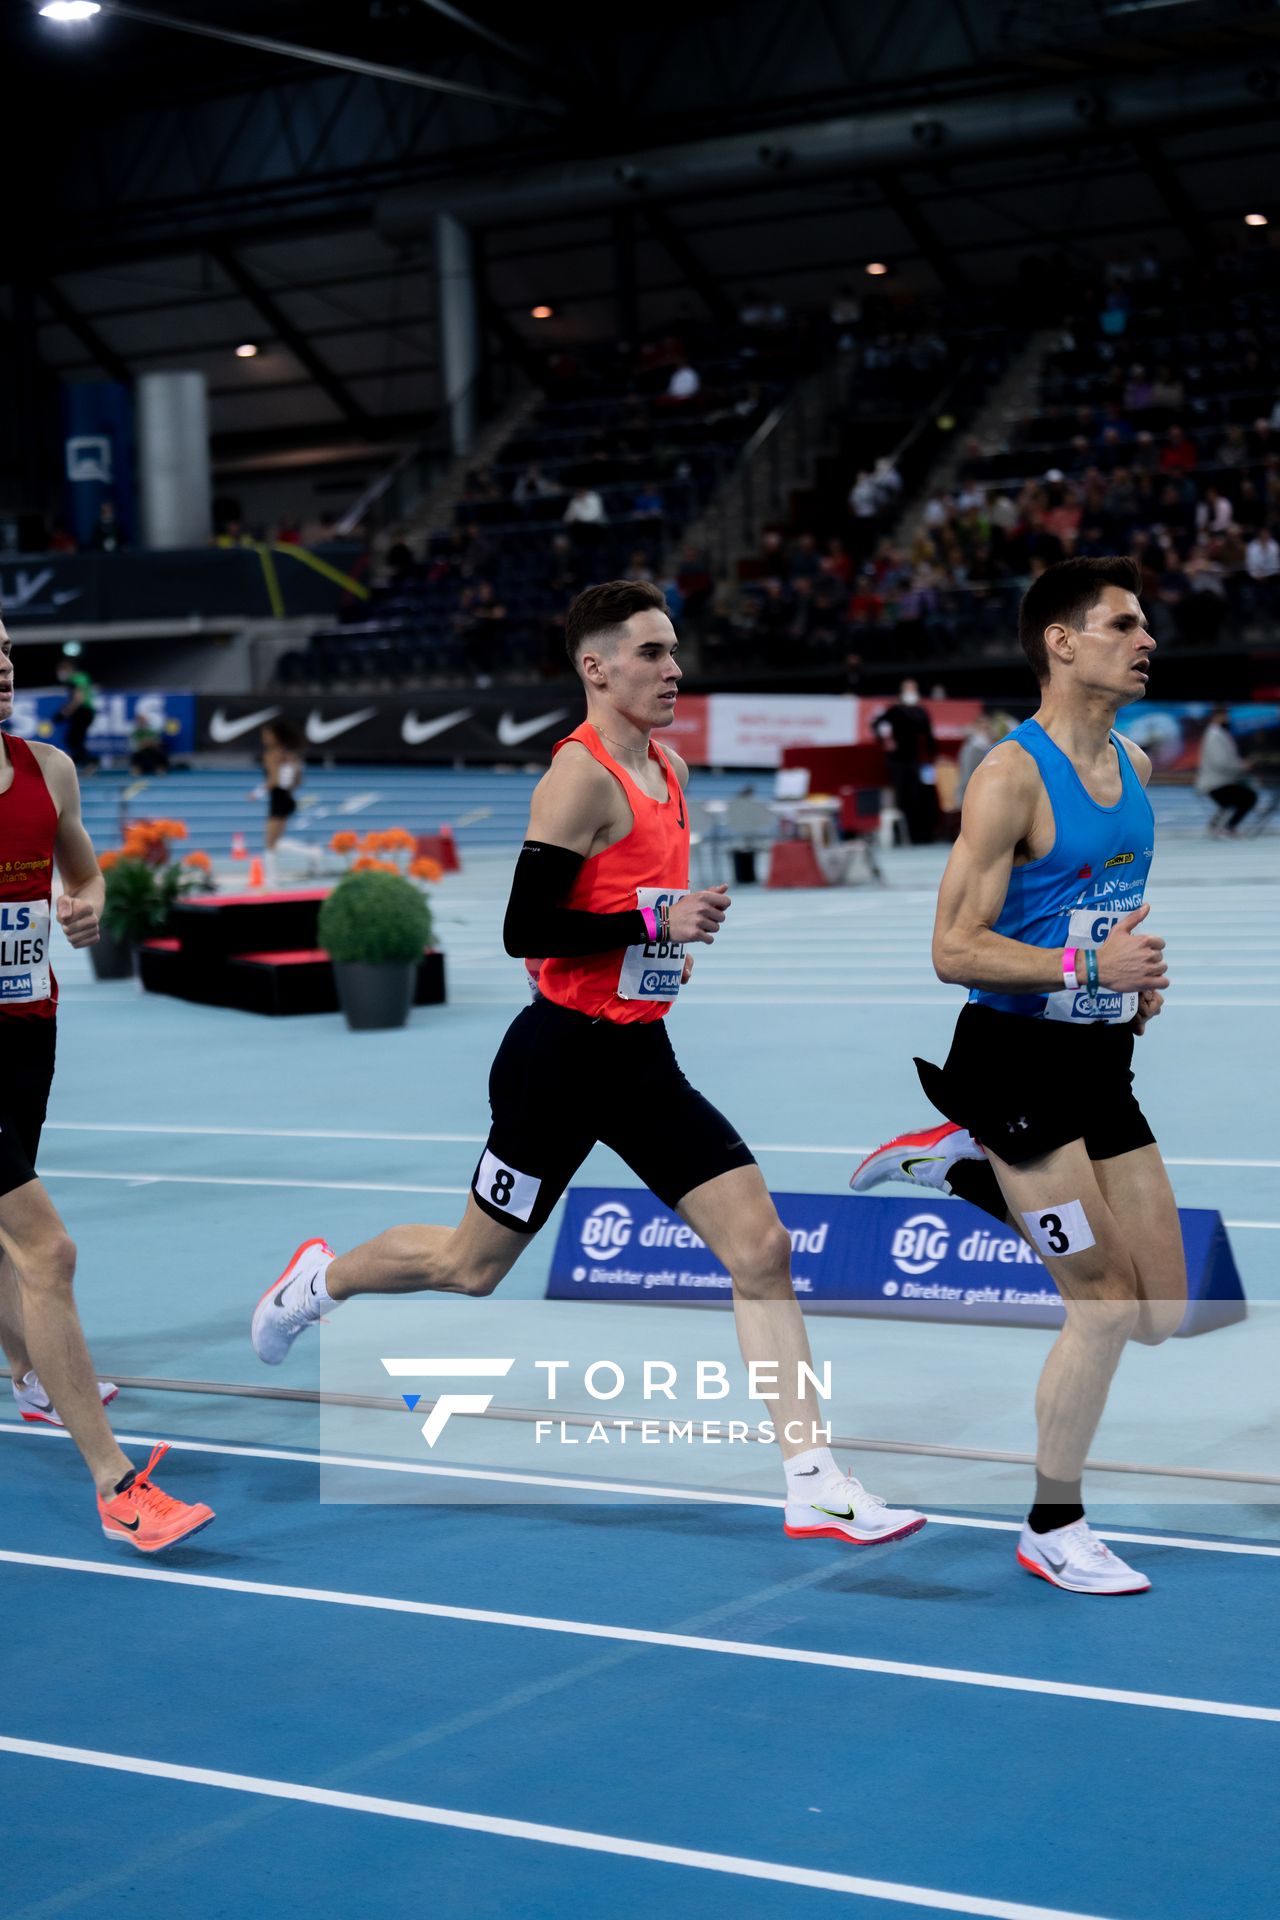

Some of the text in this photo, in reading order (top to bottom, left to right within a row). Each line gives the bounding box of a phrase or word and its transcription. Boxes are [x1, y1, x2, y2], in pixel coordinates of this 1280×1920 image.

[2, 978, 31, 990] PLAN
[1099, 997, 1121, 1009] PLAN
[490, 1168, 515, 1207] 8
[580, 1215, 633, 1248] BIG
[892, 1228, 950, 1260] BIG
[1039, 1213, 1070, 1254] 3
[589, 1268, 643, 1285] Direkter
[643, 1270, 676, 1288] geht
[902, 1282, 963, 1301] Direkter
[964, 1287, 1001, 1305] geht
